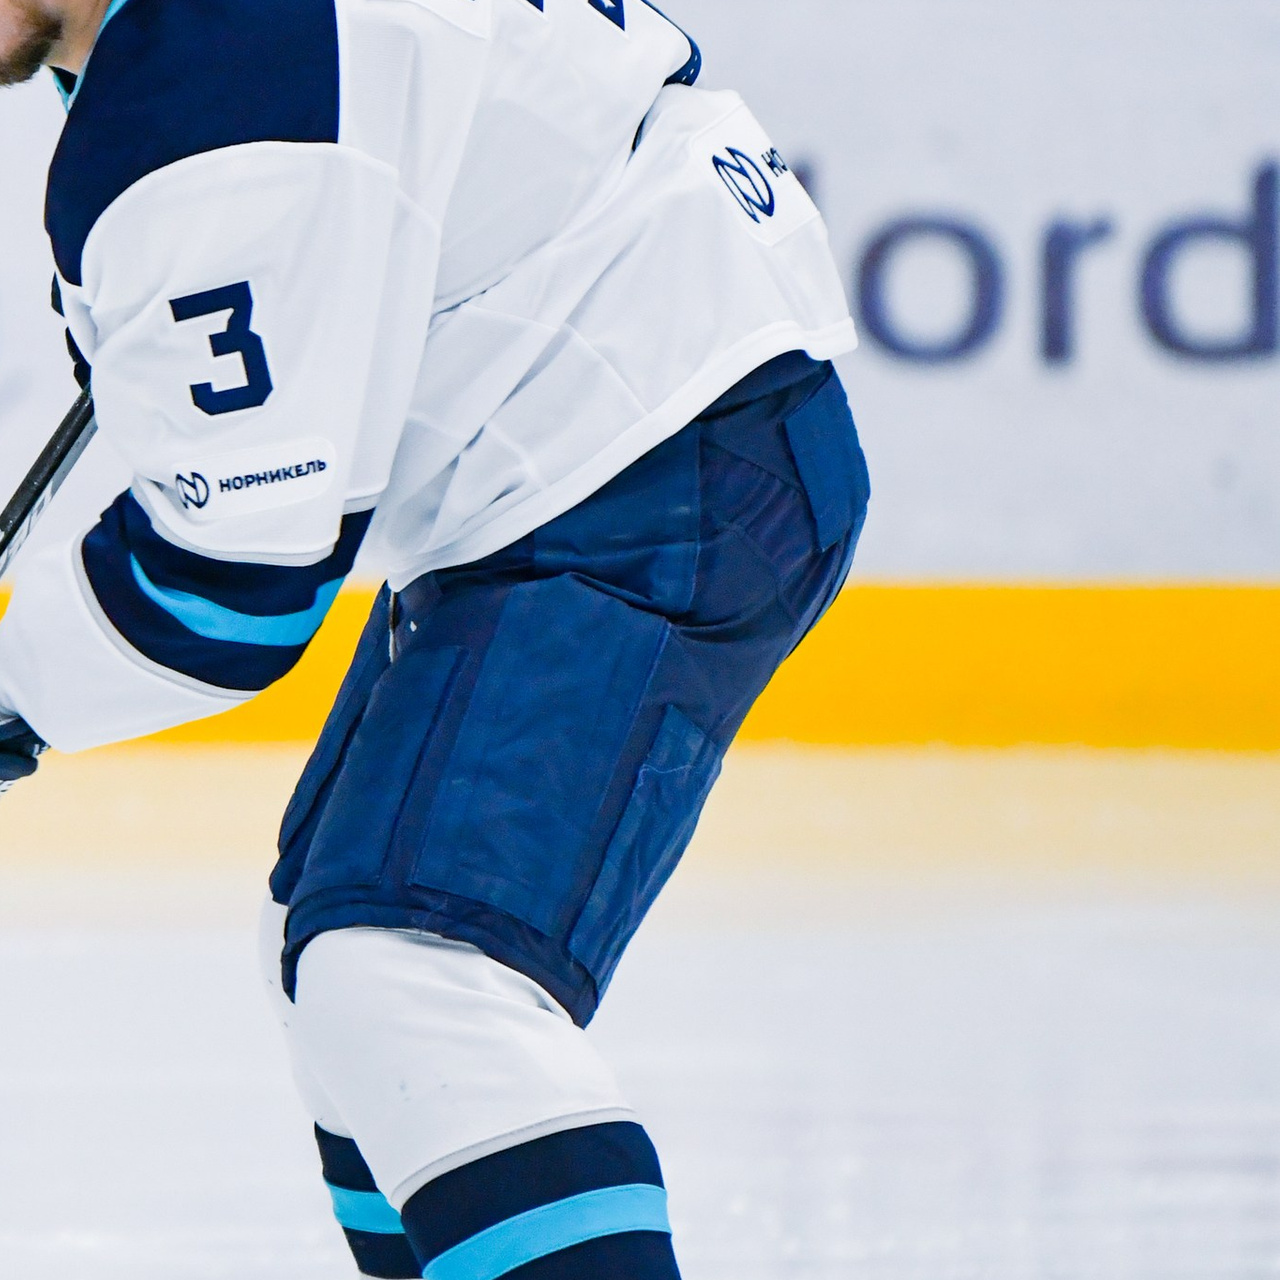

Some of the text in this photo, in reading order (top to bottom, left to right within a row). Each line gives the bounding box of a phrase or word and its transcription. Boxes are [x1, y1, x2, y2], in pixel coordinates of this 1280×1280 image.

[792, 156, 1280, 370] ord
[168, 280, 273, 416] 3
[219, 459, 327, 493] НОРНИКЕЛЬ
